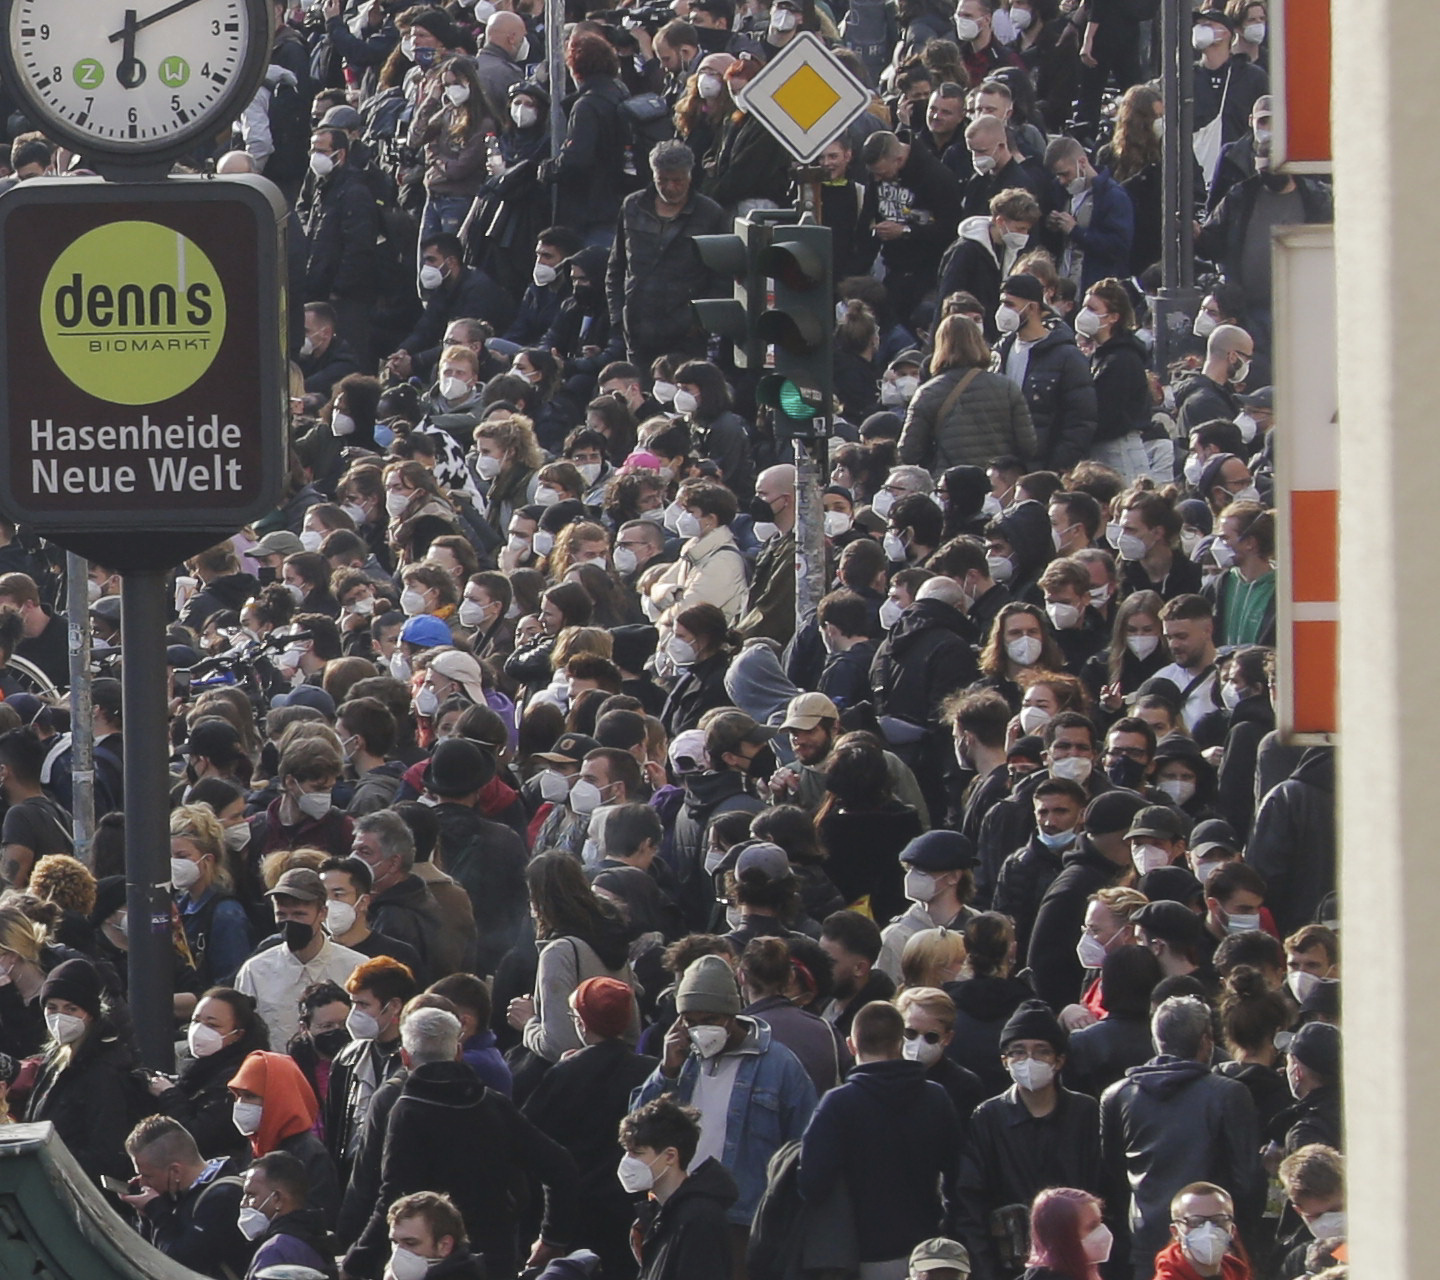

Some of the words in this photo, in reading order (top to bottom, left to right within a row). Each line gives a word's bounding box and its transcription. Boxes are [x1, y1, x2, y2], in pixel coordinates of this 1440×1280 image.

[40, 24, 50, 41] 9
[211, 19, 221, 36] 3
[52, 66, 63, 83] 8
[201, 62, 211, 79] 4
[84, 97, 95, 113] 7
[170, 95, 181, 112] 5
[127, 107, 138, 123] 6
[89, 338, 211, 353] BIOMARKT
[30, 414, 242, 452] Hasenheide
[32, 458, 137, 494] Neue
[148, 453, 243, 492] Welt
